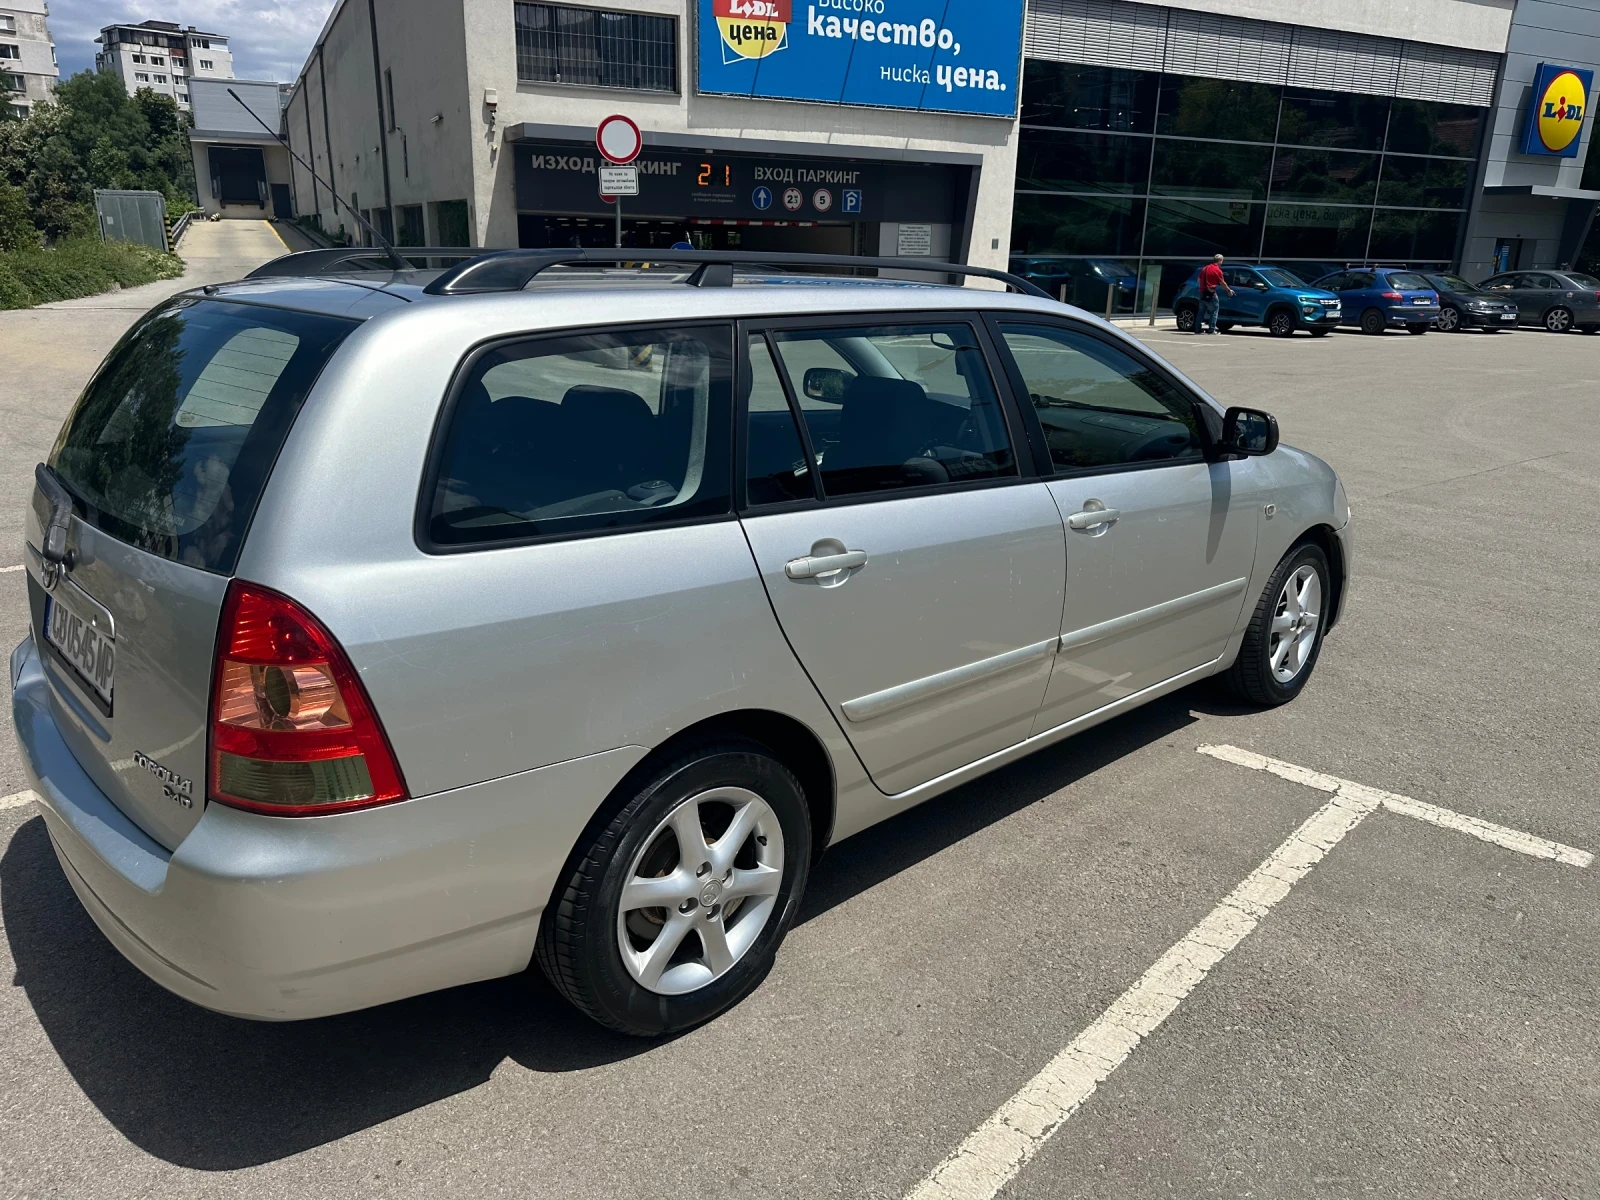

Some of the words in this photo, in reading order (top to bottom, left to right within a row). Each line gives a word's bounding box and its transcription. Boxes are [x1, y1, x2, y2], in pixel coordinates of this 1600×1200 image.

[729, 24, 777, 45] цена
[807, 4, 961, 56] качество,
[880, 63, 931, 86] ниска
[936, 64, 1007, 93] цена.
[1543, 96, 1583, 123] LIDL
[531, 154, 596, 174] ИЗХОД
[697, 163, 730, 187] 21
[754, 166, 794, 184] ВХОД
[797, 168, 860, 184] ПАРКИНГ
[819, 196, 826, 205] 5
[847, 197, 856, 211] P
[1267, 206, 1290, 219] иска
[1293, 208, 1320, 222] цена,
[132, 750, 192, 794] COROLLA
